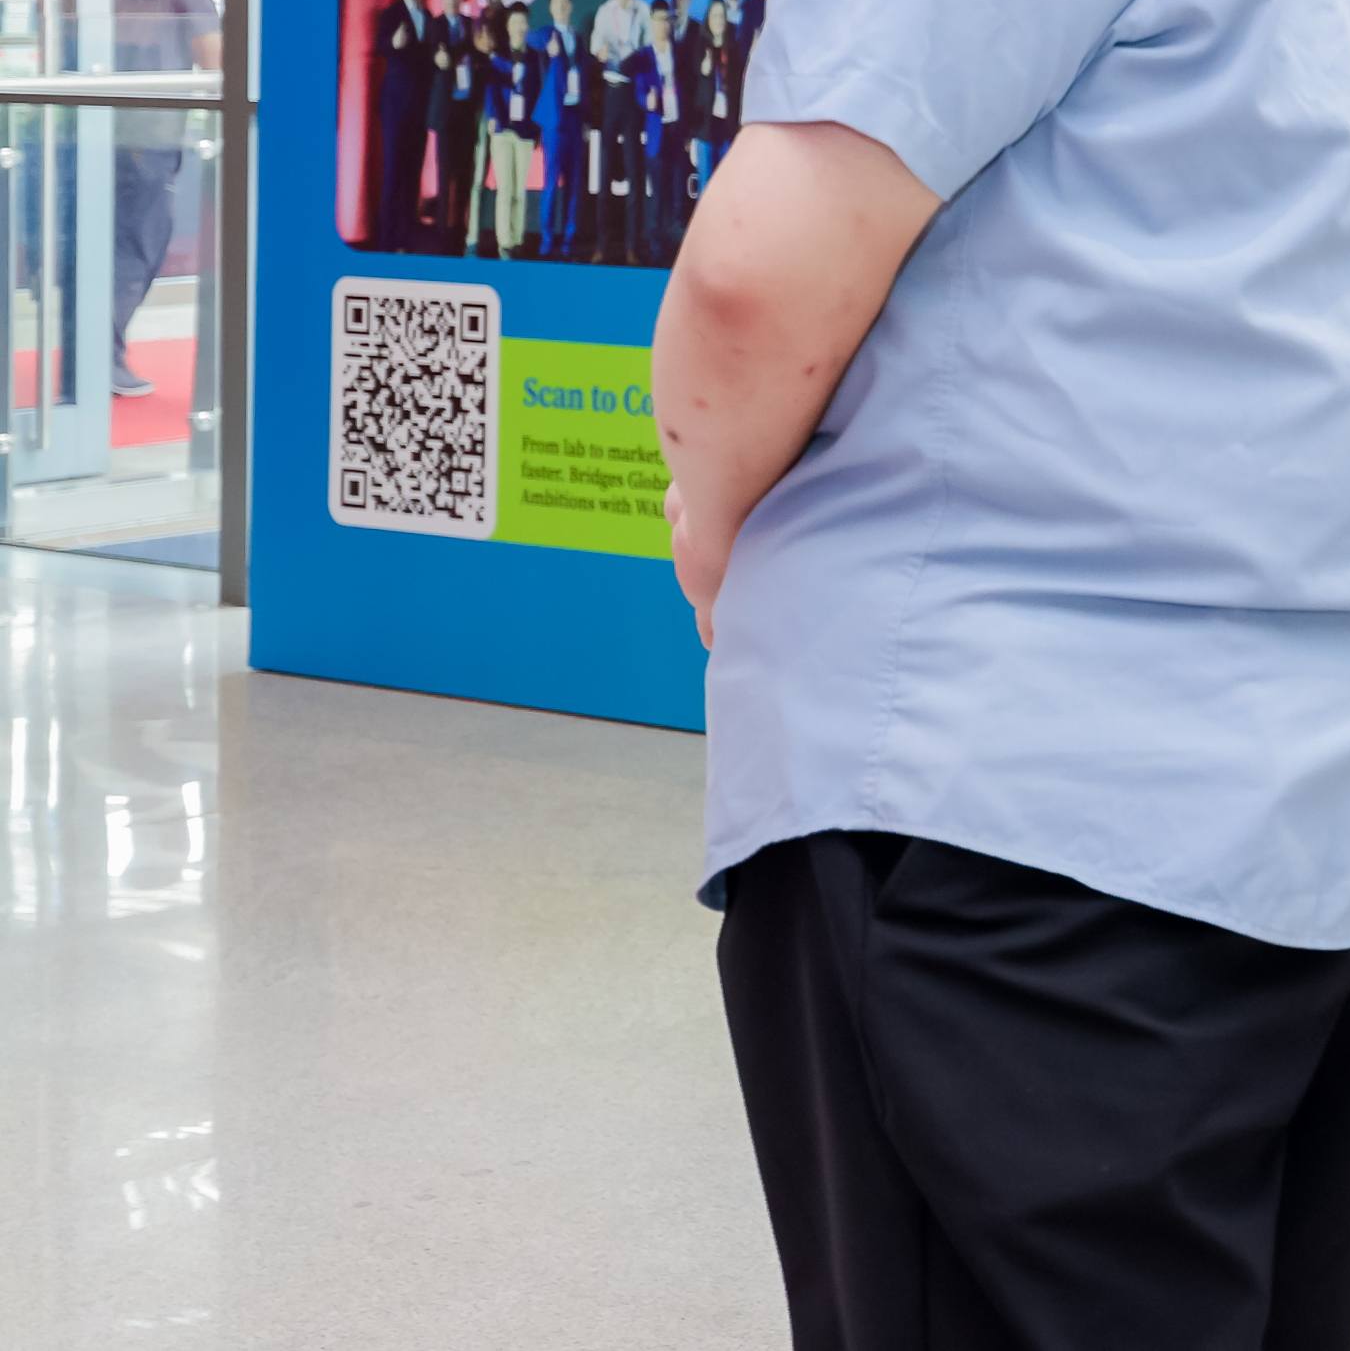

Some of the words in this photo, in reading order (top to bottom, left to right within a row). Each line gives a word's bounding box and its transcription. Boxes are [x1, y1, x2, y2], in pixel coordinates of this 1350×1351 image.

[523, 377, 585, 411] Scan
[591, 386, 617, 413] to
[522, 435, 559, 456] From
[563, 438, 586, 458] lab
[590, 443, 604, 459] to
[521, 461, 564, 481] faster.
[570, 466, 623, 491] Bridges
[523, 489, 595, 511] Ambitions
[599, 497, 631, 516] with
